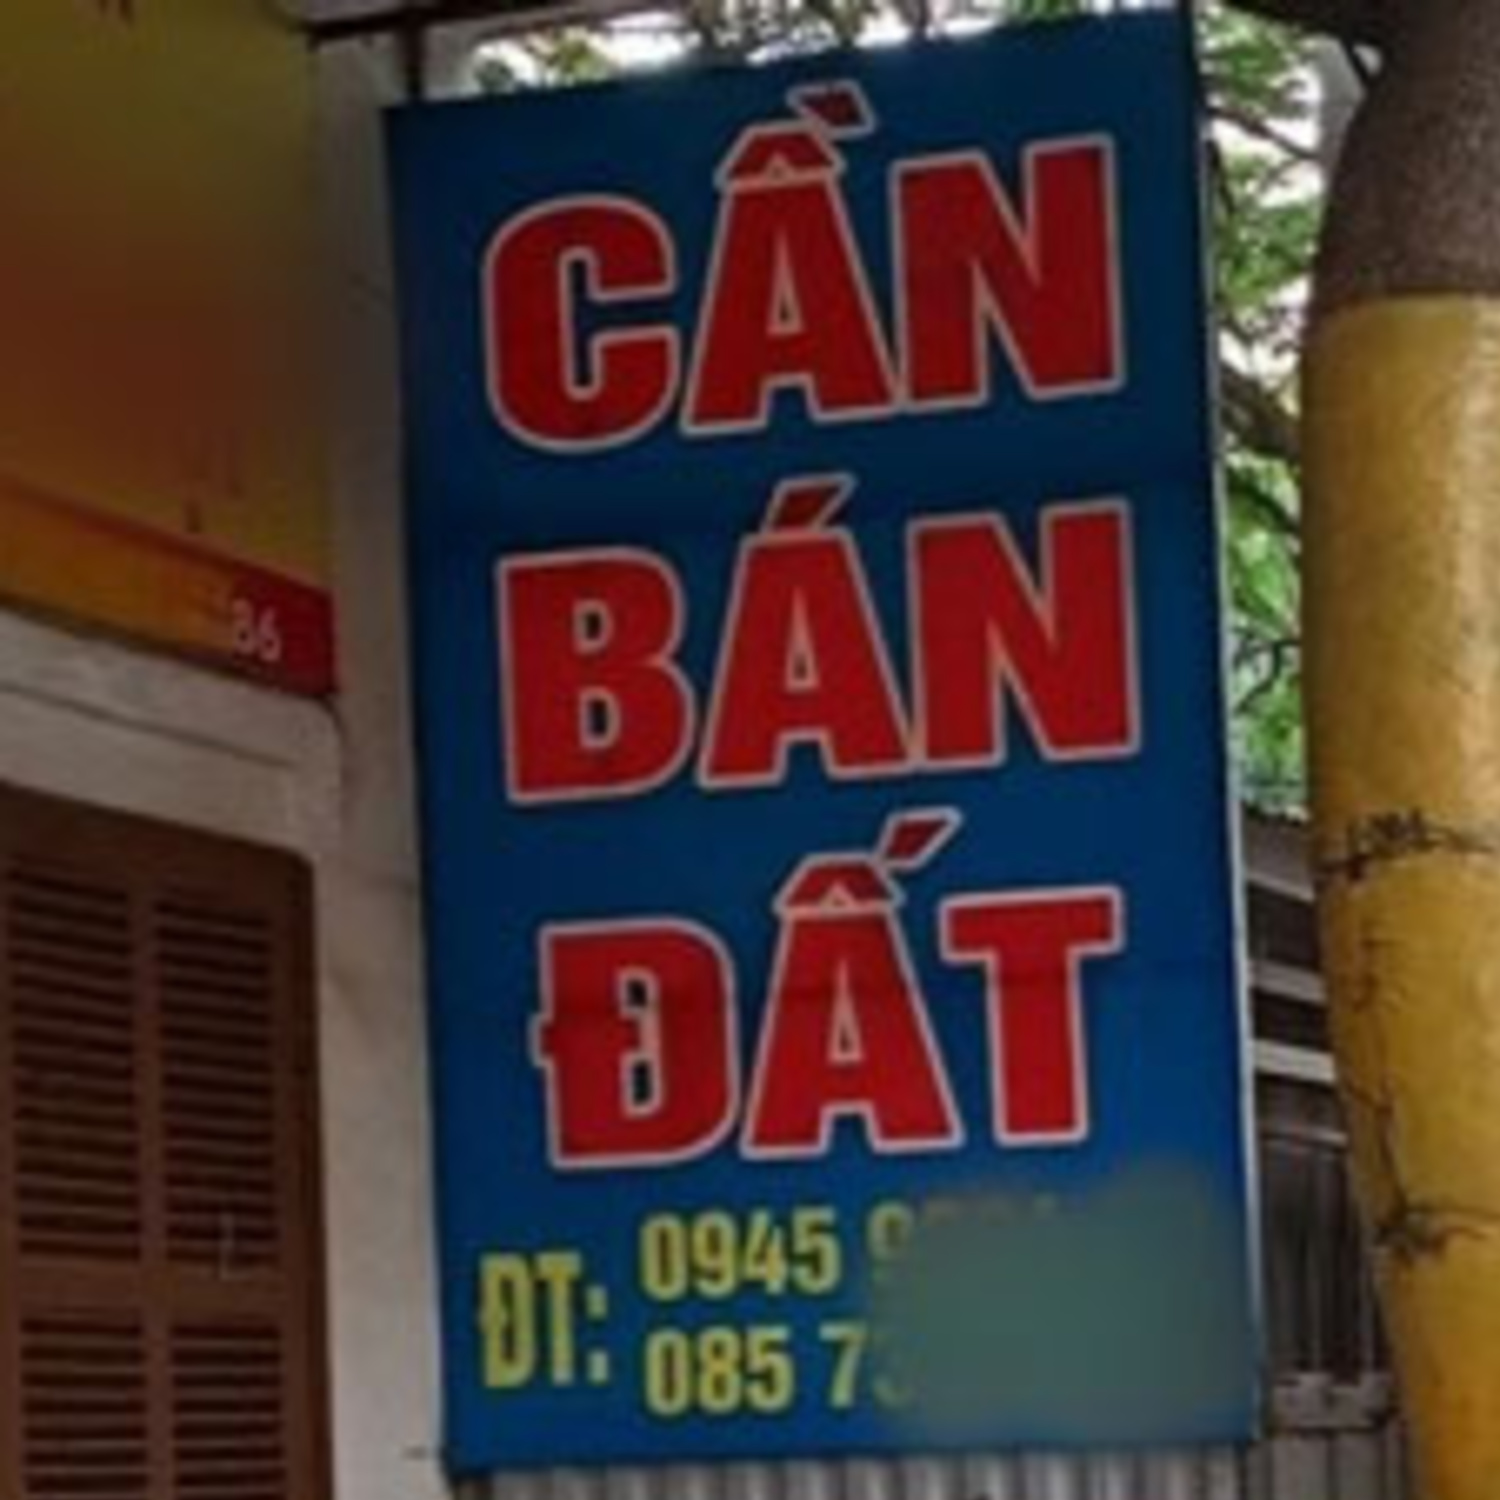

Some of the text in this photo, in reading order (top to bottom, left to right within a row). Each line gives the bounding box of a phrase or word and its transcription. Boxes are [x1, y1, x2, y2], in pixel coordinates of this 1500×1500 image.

[483, 81, 1125, 452] CẦN
[497, 474, 1141, 803] BÁN
[530, 808, 1124, 1170] ĐẤT
[478, 1250, 609, 1388] ĐT:
[639, 1207, 841, 1301] 0945
[646, 1325, 795, 1416] 085
